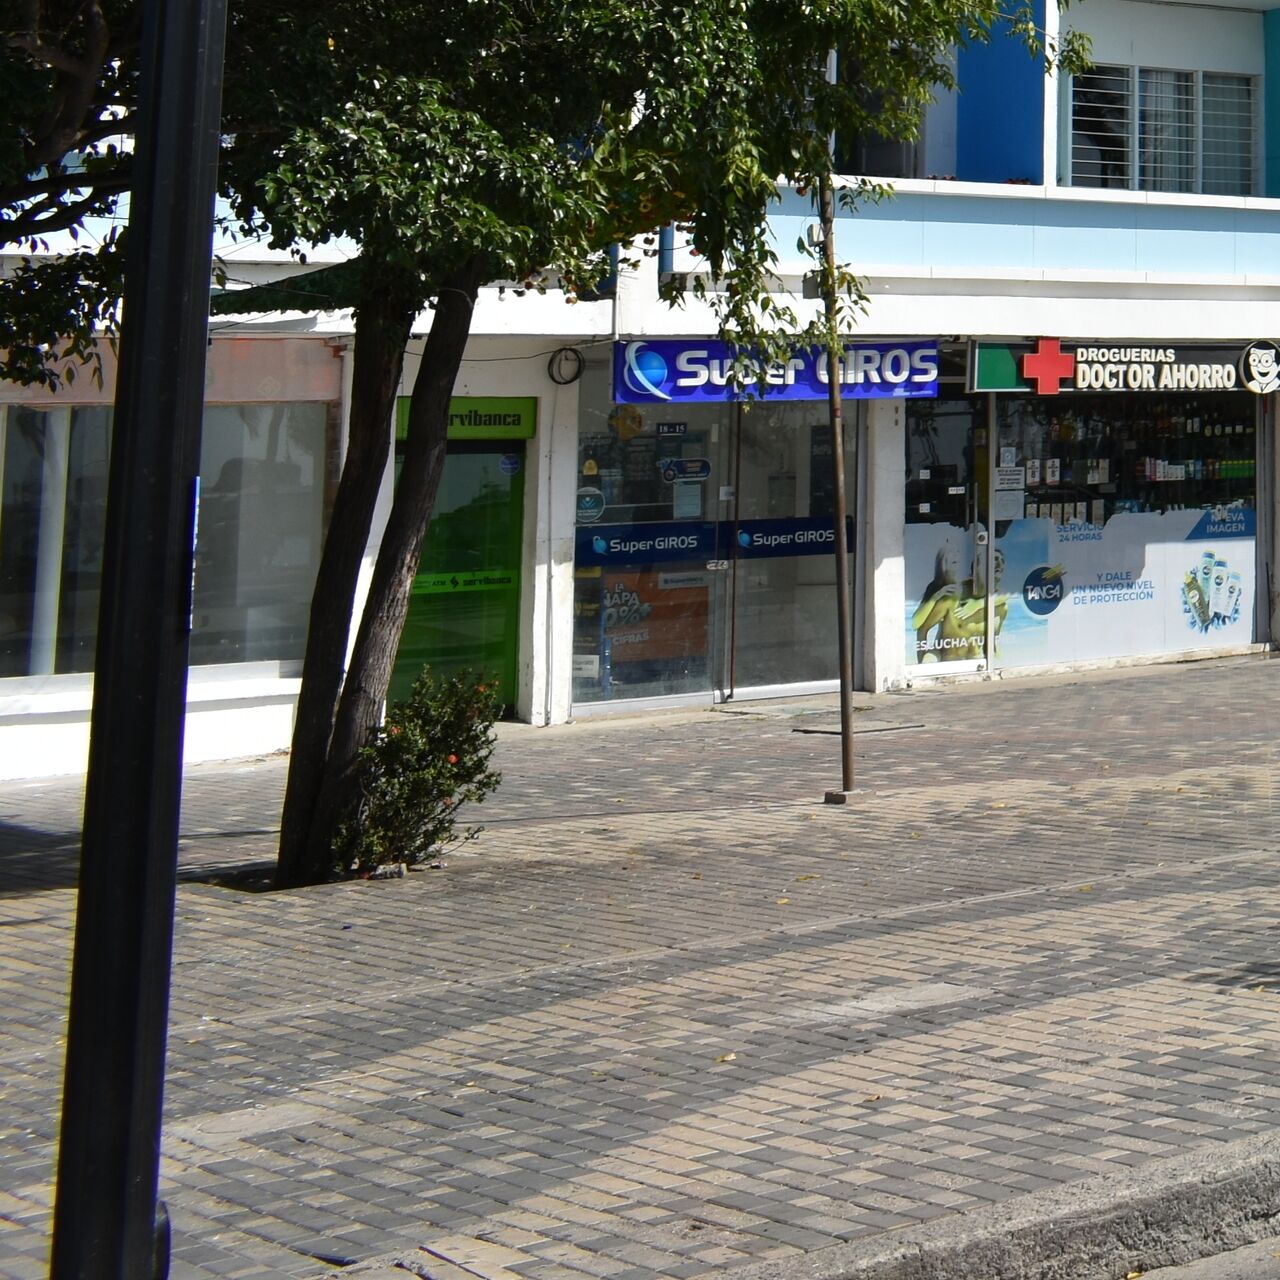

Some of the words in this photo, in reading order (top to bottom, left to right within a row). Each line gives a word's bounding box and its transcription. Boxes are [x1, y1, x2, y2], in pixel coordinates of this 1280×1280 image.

[1076, 347, 1175, 362] DROGUERIAS
[816, 349, 938, 384] GIROS
[1076, 363, 1155, 388] DOCTOR
[1159, 364, 1236, 388] AHORRO
[448, 409, 521, 426] rvibanca
[1211, 512, 1245, 522] NEVA
[1207, 522, 1245, 533] IMAGEN
[610, 537, 654, 553] Super
[655, 535, 697, 549] GIROS
[753, 533, 794, 548] Super
[795, 530, 835, 543] GIROS
[1059, 534, 1070, 543] 24
[1072, 532, 1102, 542] HORAS
[1096, 573, 1105, 581] Y
[1106, 571, 1132, 581] DALE
[615, 583, 624, 592] LA
[1026, 585, 1061, 600] TANGA
[1072, 586, 1087, 594] UN
[1089, 583, 1124, 594] NUEVO
[1127, 579, 1155, 591] NIVEL
[1073, 596, 1085, 605] DE
[1087, 591, 1154, 604] PROTECCIÓN
[612, 632, 650, 645] CIFRAS
[916, 638, 968, 651] ESCUCHA
[970, 636, 985, 646] TU
